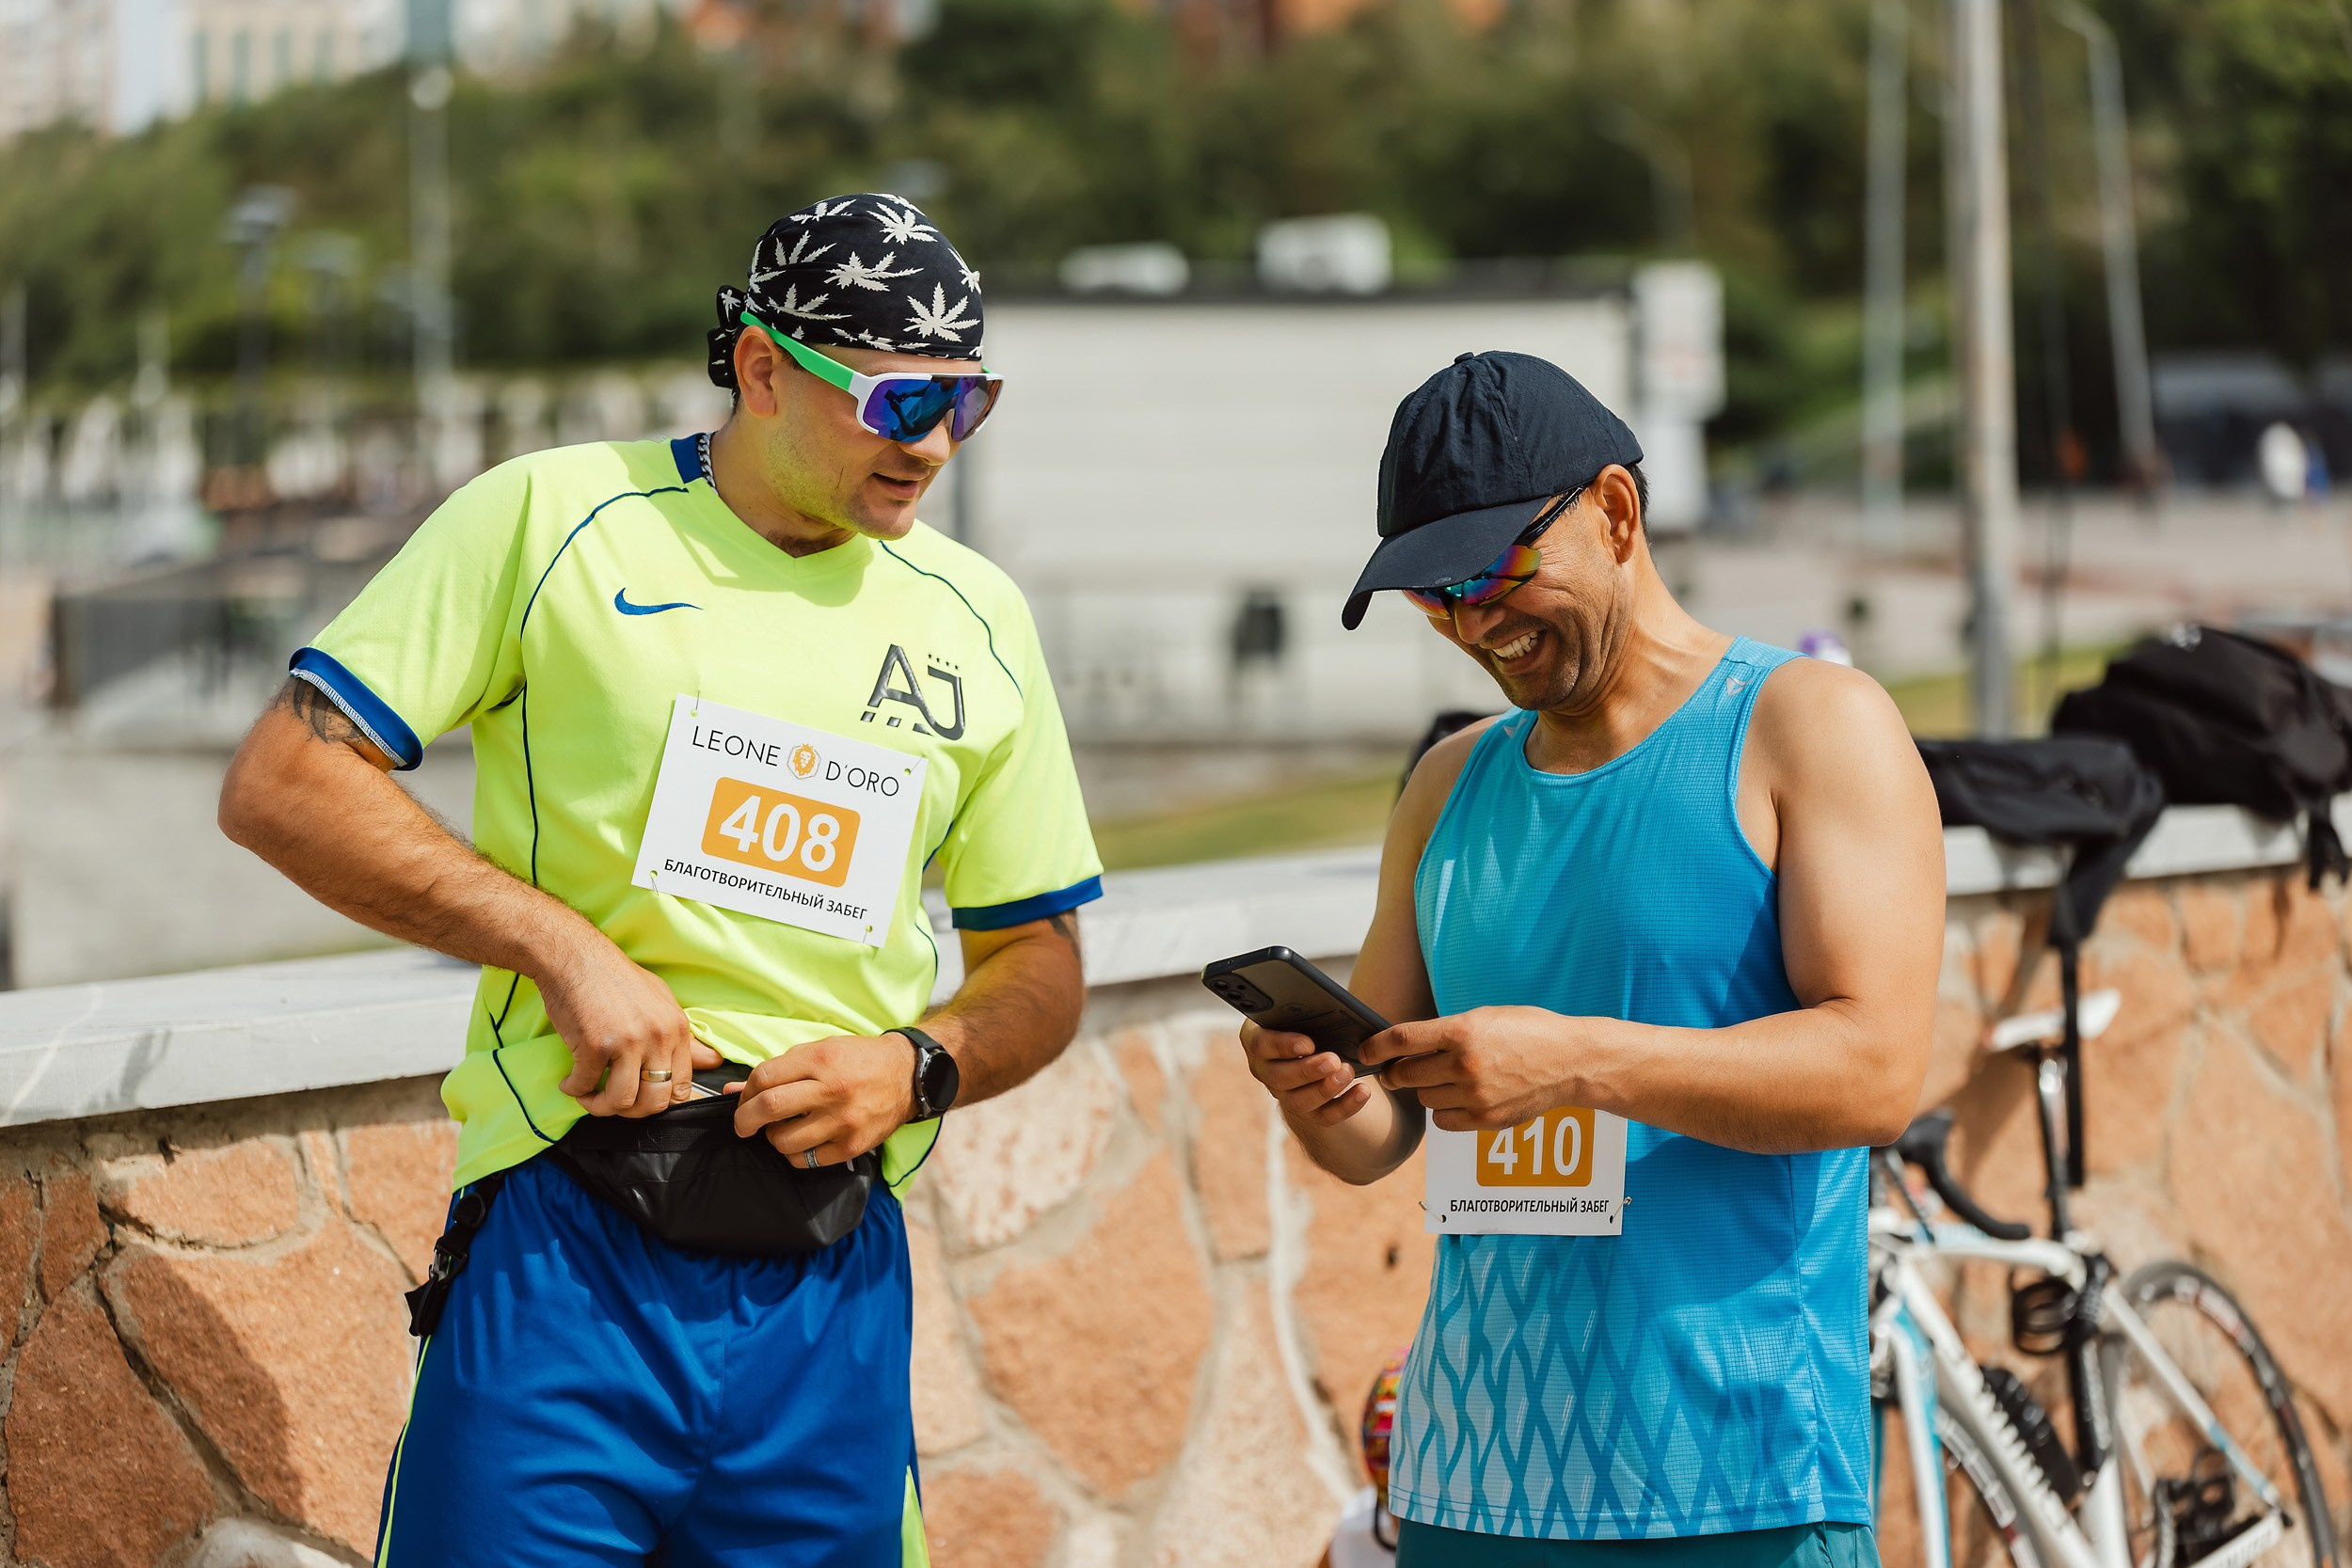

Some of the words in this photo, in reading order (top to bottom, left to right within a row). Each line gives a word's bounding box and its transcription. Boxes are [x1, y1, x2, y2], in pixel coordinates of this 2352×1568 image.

[691, 725, 782, 767] LEONE
[825, 760, 899, 797] D'ORO
[719, 794, 840, 872] 408
[663, 858, 824, 910] БЛАГОТВОРИТЕЛЬНЫЙ
[826, 899, 867, 920] ЗАБЕГ
[1487, 1116, 1581, 1176] 410
[1450, 1196, 1578, 1213] БЛАГОТВОРИТЕЛЬНЫЙ
[1581, 1199, 1610, 1213] ЗАБЕГ
